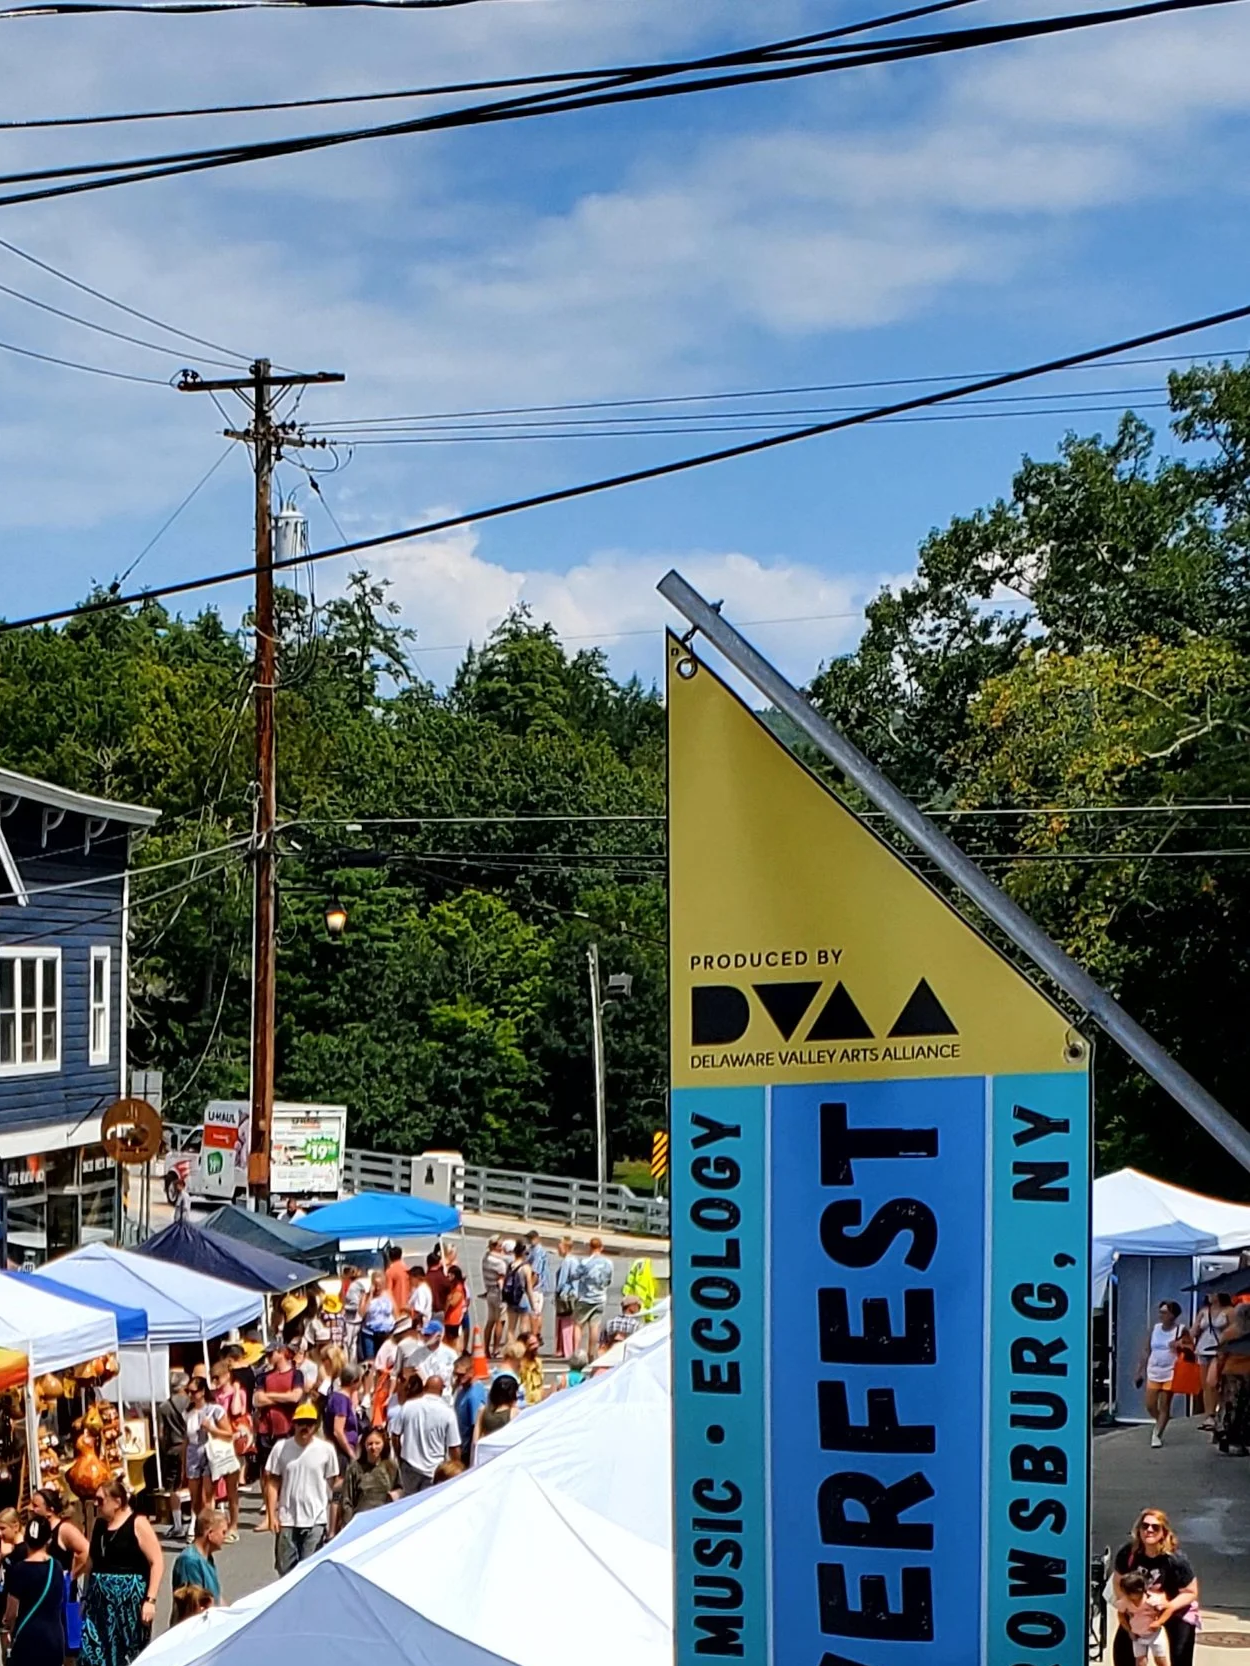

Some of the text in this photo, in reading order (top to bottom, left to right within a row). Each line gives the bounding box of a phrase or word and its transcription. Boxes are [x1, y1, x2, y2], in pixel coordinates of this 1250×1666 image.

[690, 949, 843, 970] PRODUCED BY
[690, 1044, 961, 1069] DELAWARE VALLEY ARTS ALLIANCE
[1011, 1104, 1071, 1203] NY
[690, 1112, 742, 1395] ECOLOGY
[691, 1477, 744, 1657] MUSIC
